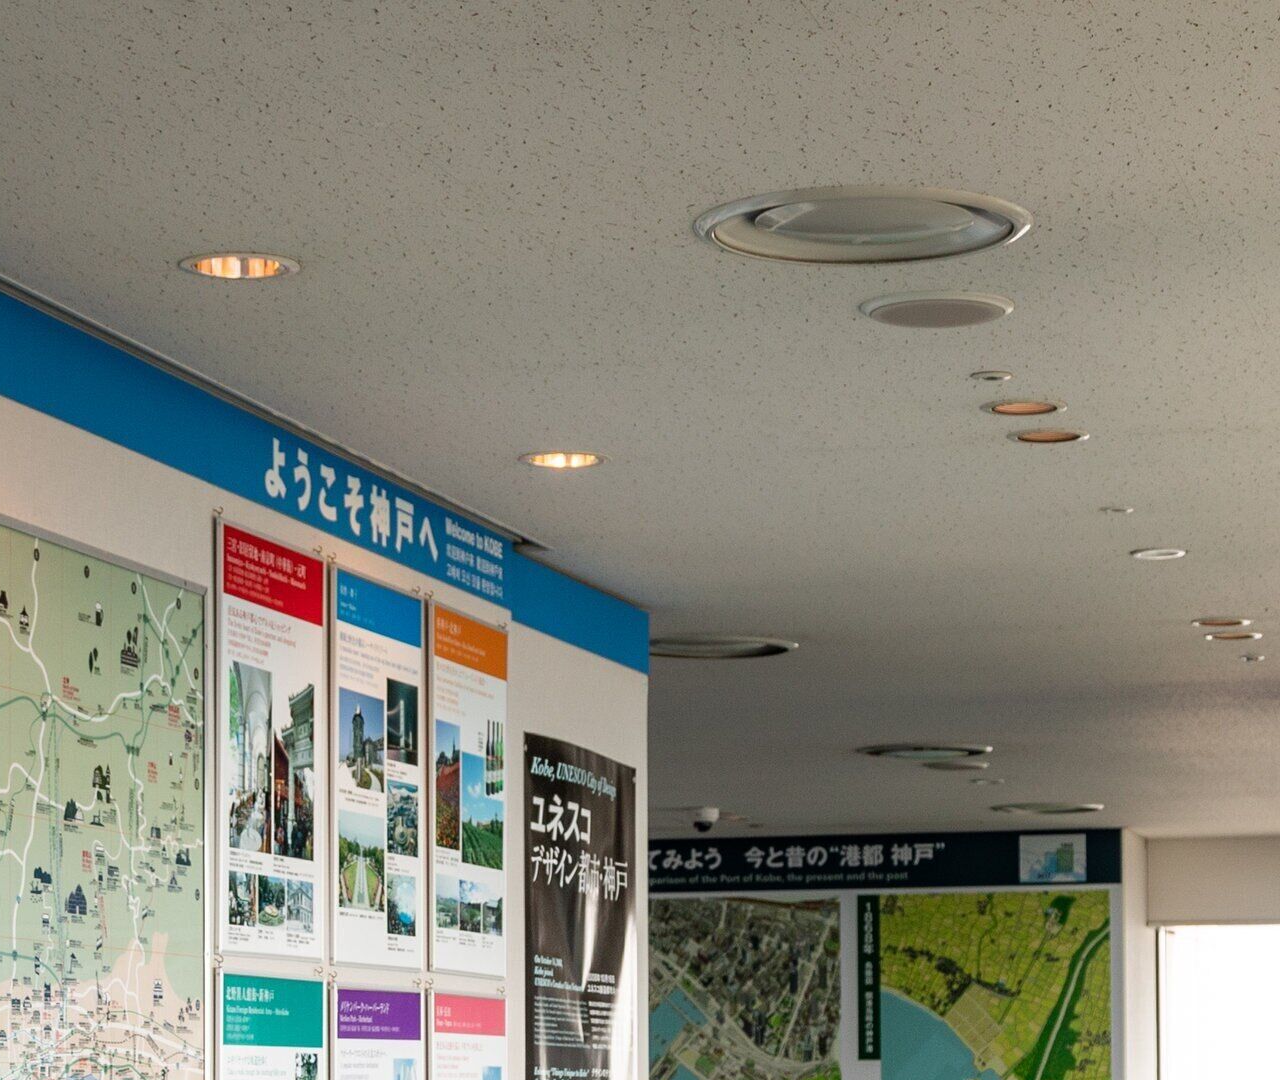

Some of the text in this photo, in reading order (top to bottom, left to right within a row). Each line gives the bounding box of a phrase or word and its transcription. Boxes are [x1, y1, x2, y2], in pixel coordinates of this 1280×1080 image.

[264, 437, 439, 564] ようこそ神戸へ
[445, 516, 503, 560] Welcome to KOBE
[531, 756, 555, 782] Kobe,
[556, 762, 587, 786] UNESCO
[530, 794, 592, 845] ユネスコ
[531, 845, 628, 901] デザイン都市・神戸
[647, 841, 946, 870] てみよう 今と昔の“港都 神戸”
[688, 875, 698, 884] of
[701, 875, 719, 884] the
[721, 874, 740, 883] Port
[743, 874, 753, 883] of
[787, 873, 803, 882] the
[846, 872, 865, 881] and
[868, 871, 884, 881] the
